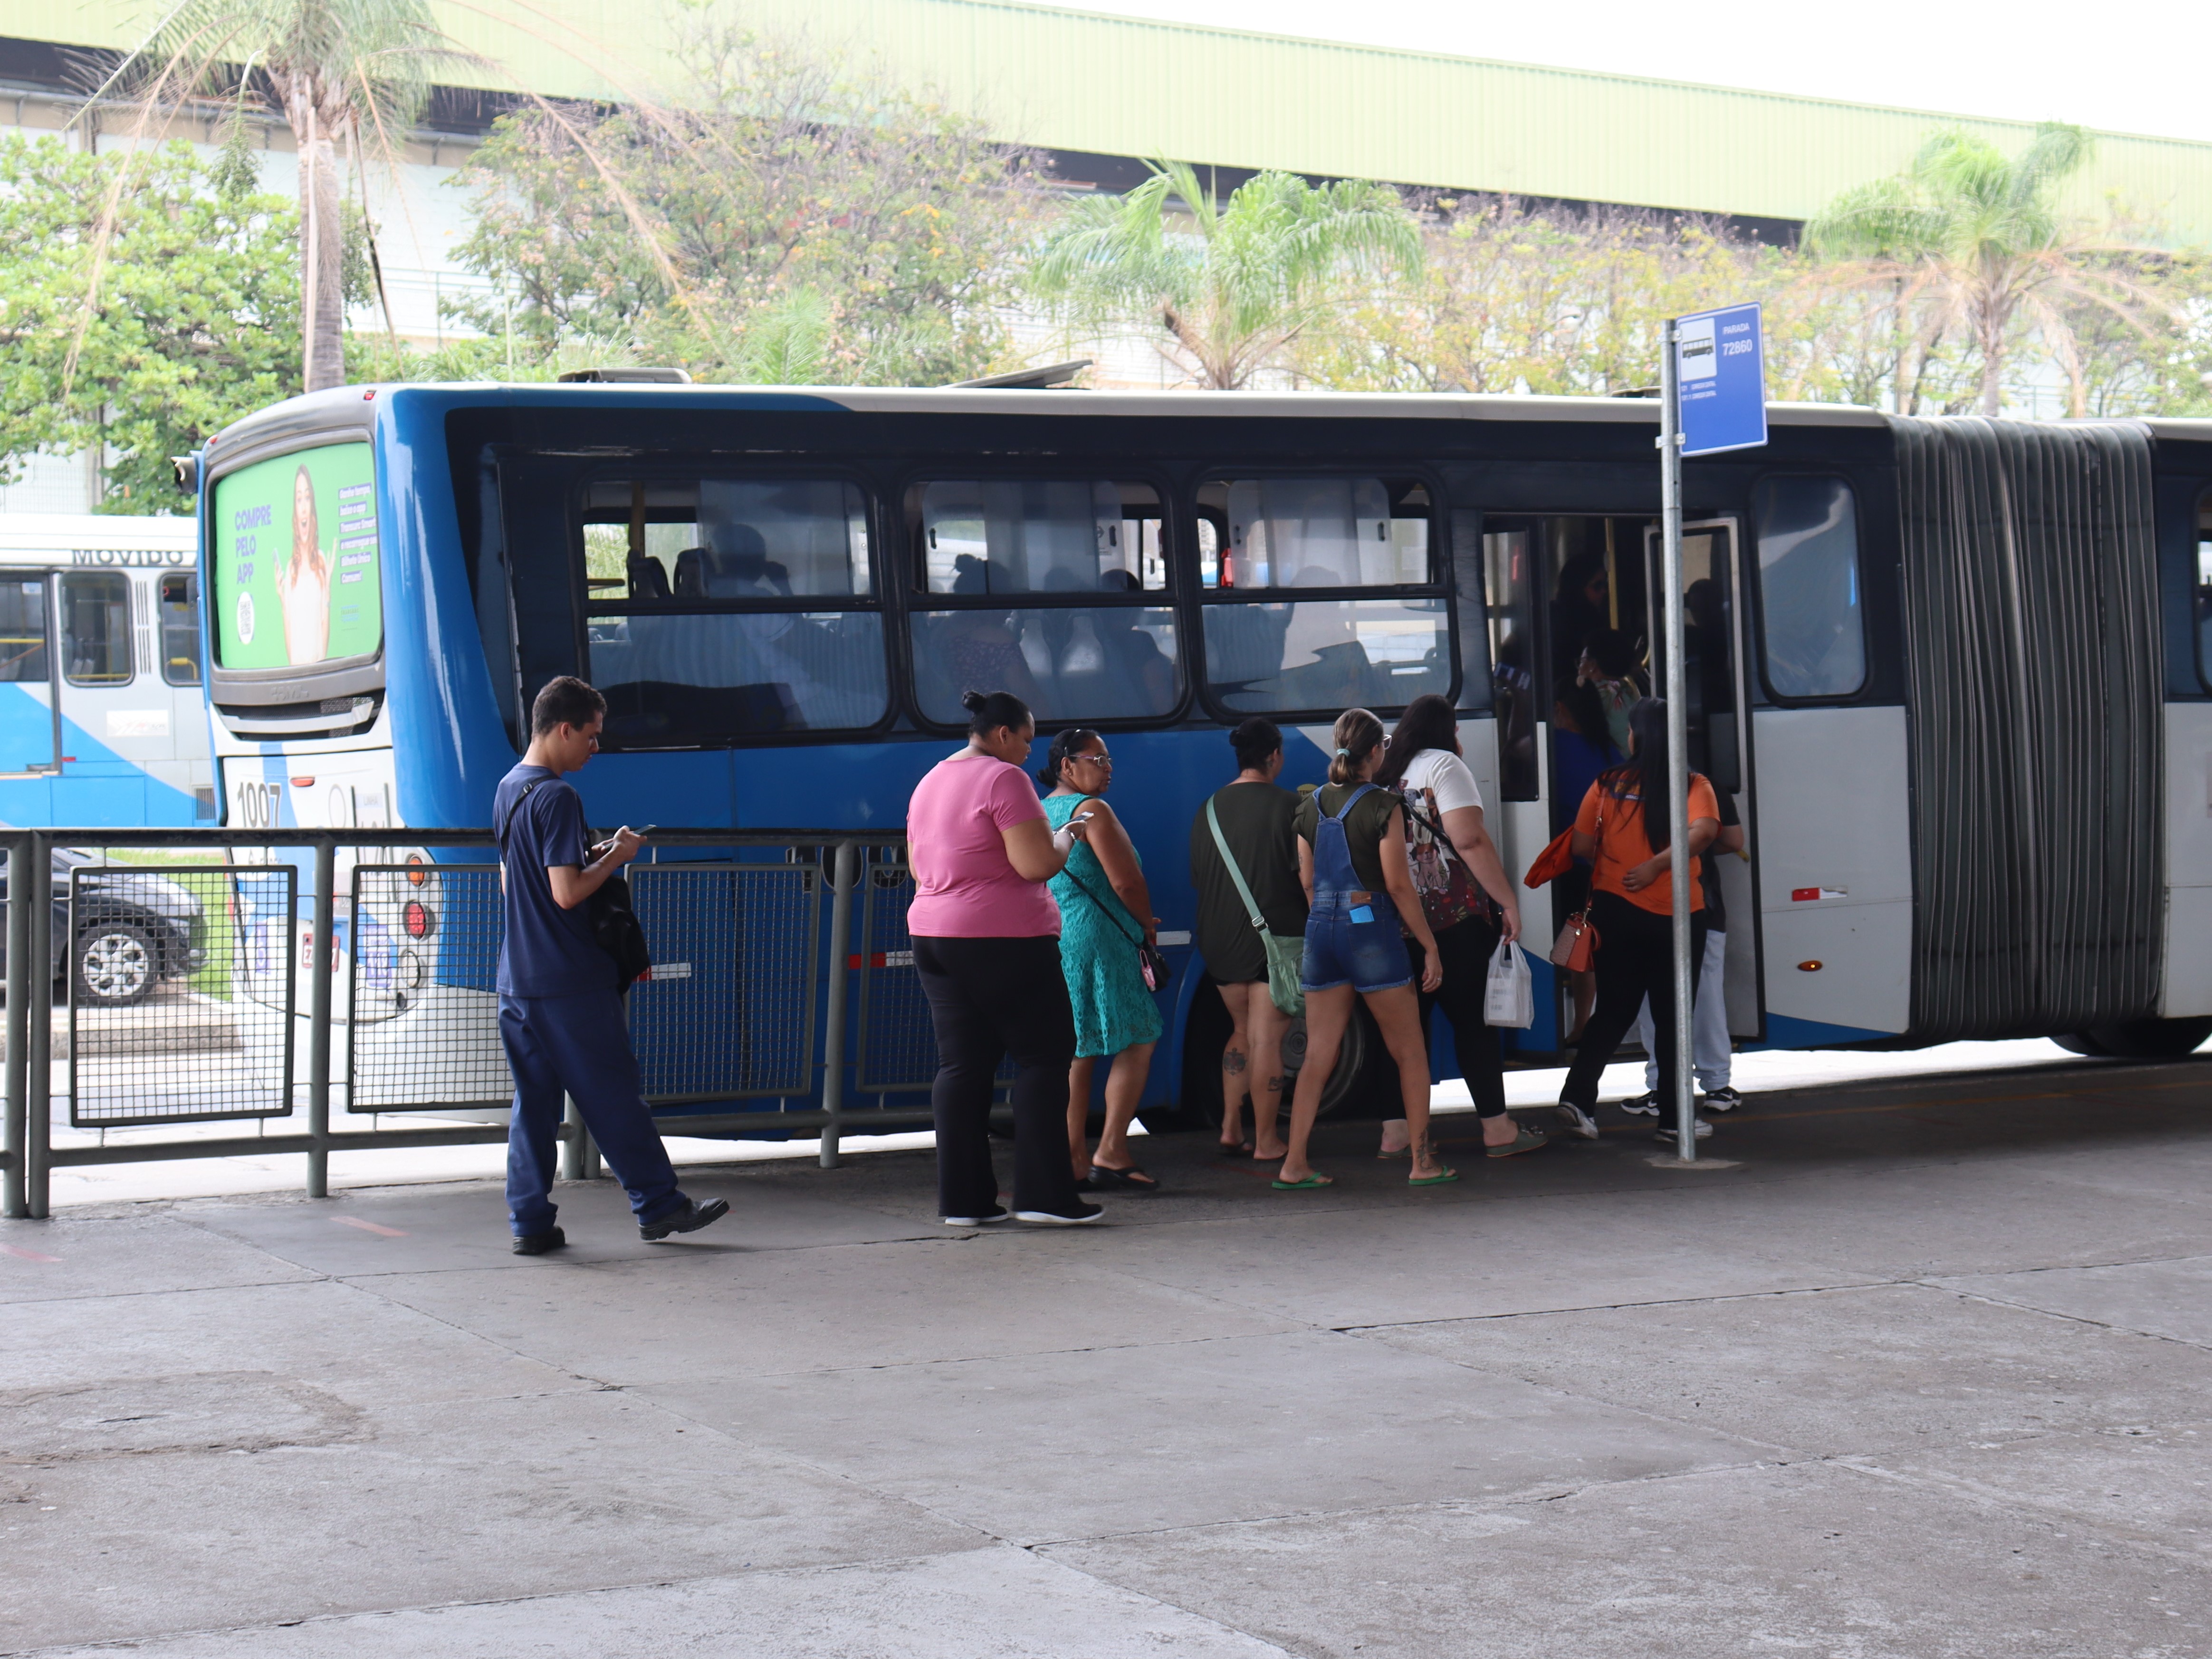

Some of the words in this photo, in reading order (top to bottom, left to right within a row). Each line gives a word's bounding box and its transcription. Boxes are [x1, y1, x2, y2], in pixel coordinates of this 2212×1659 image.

[1722, 323, 1751, 335] PARADA
[1722, 339, 1753, 356] 72860
[235, 504, 272, 531] COMPRE
[71, 549, 183, 567] MOVIDO
[235, 534, 257, 558] PELO
[237, 561, 254, 585] APP
[237, 782, 281, 828] 1007
